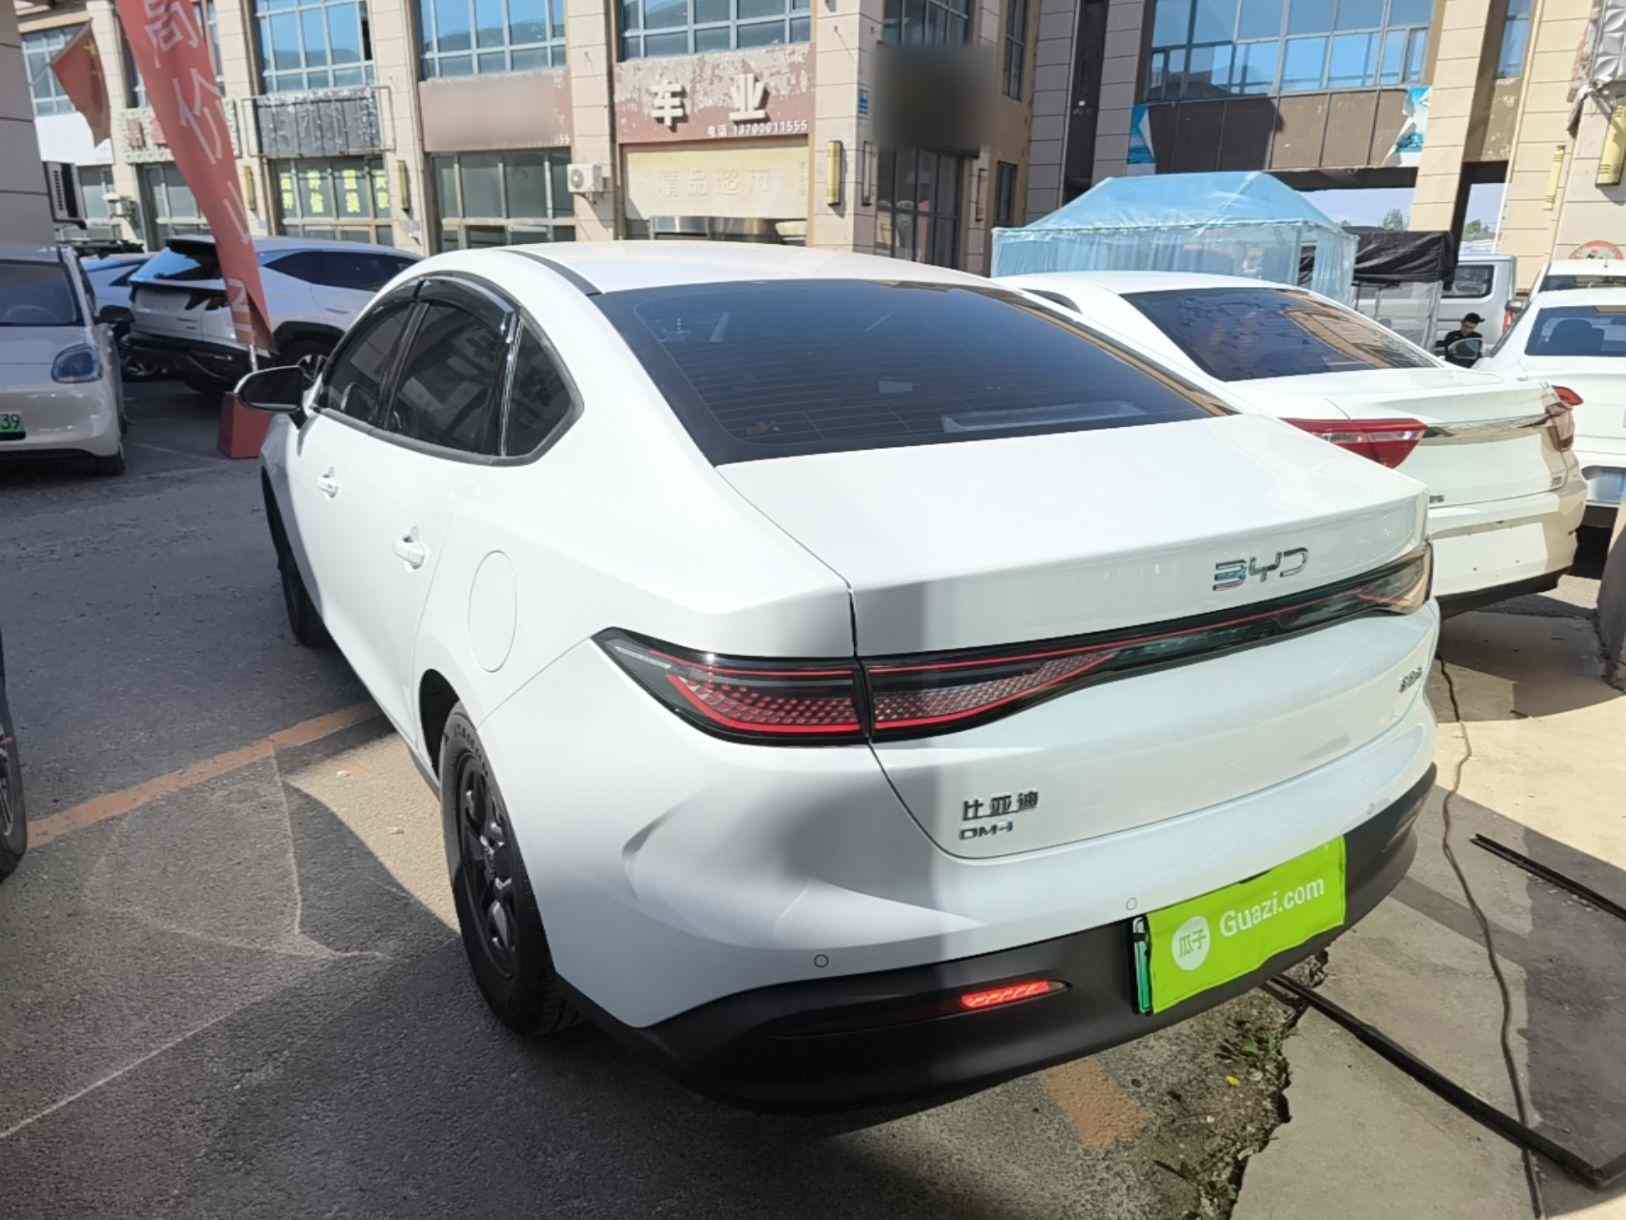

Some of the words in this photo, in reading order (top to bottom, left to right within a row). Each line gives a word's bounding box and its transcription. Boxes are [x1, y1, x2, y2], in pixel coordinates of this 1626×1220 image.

[650, 73, 768, 127] 车业
[1212, 547, 1309, 591] BYD
[962, 791, 1038, 821] 比亚迪
[1219, 878, 1325, 938] Guazi.com
[1178, 928, 1207, 958] 瓜子
